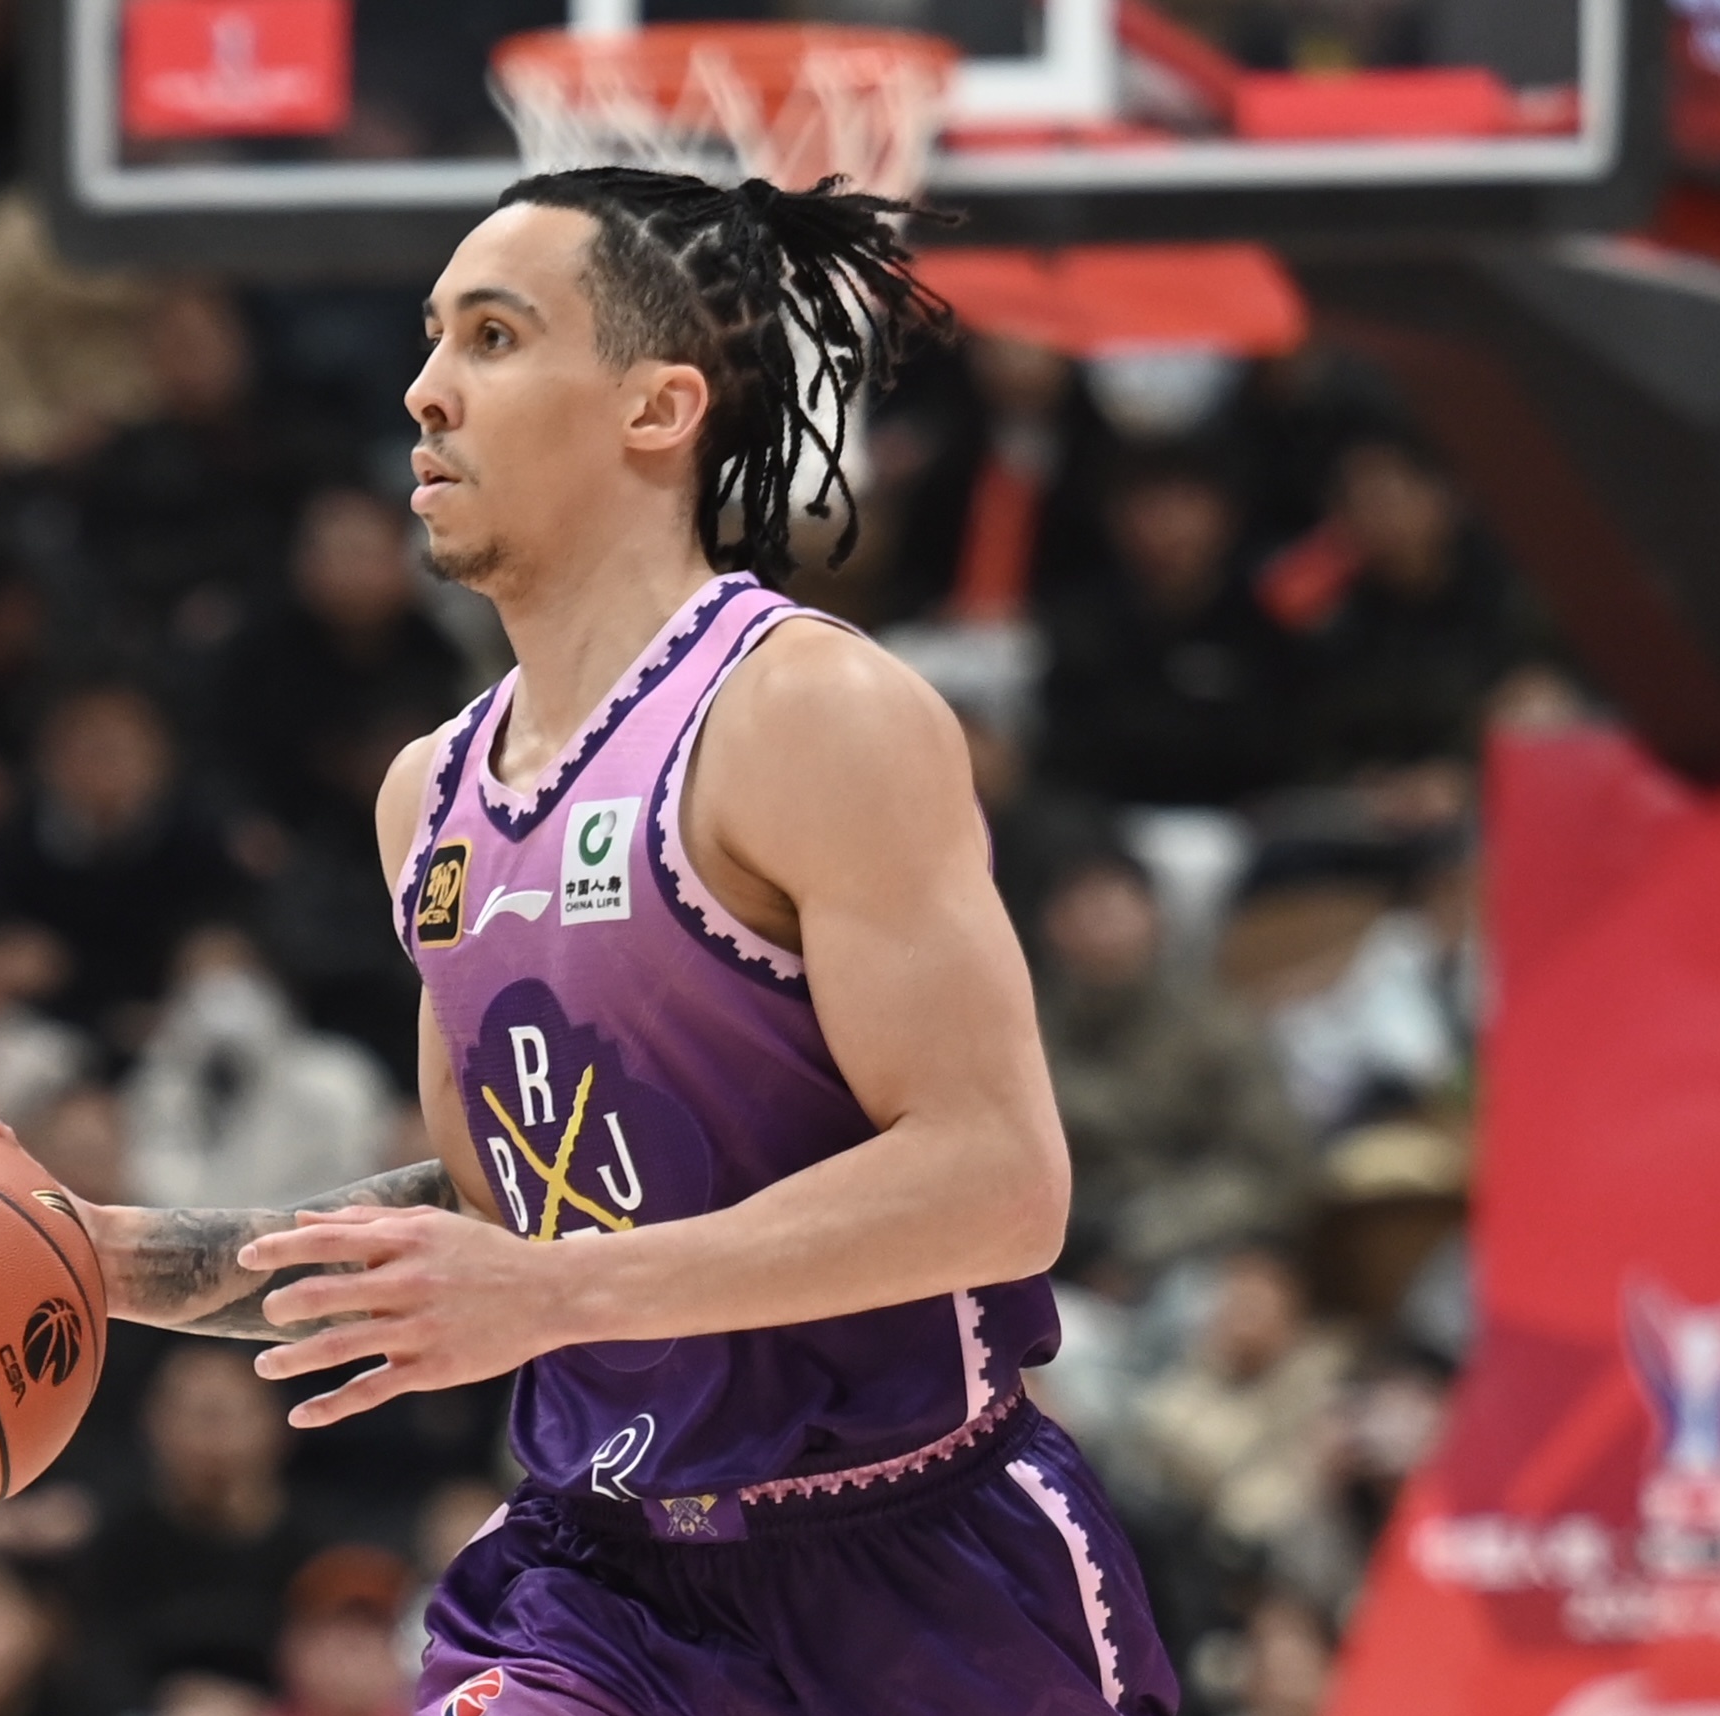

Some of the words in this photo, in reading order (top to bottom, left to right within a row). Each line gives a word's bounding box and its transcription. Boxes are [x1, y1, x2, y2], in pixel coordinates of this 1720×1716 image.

[565, 901, 593, 913] CHINA
[597, 897, 621, 908] LIFE
[508, 1025, 556, 1127] R
[596, 1111, 643, 1211] J
